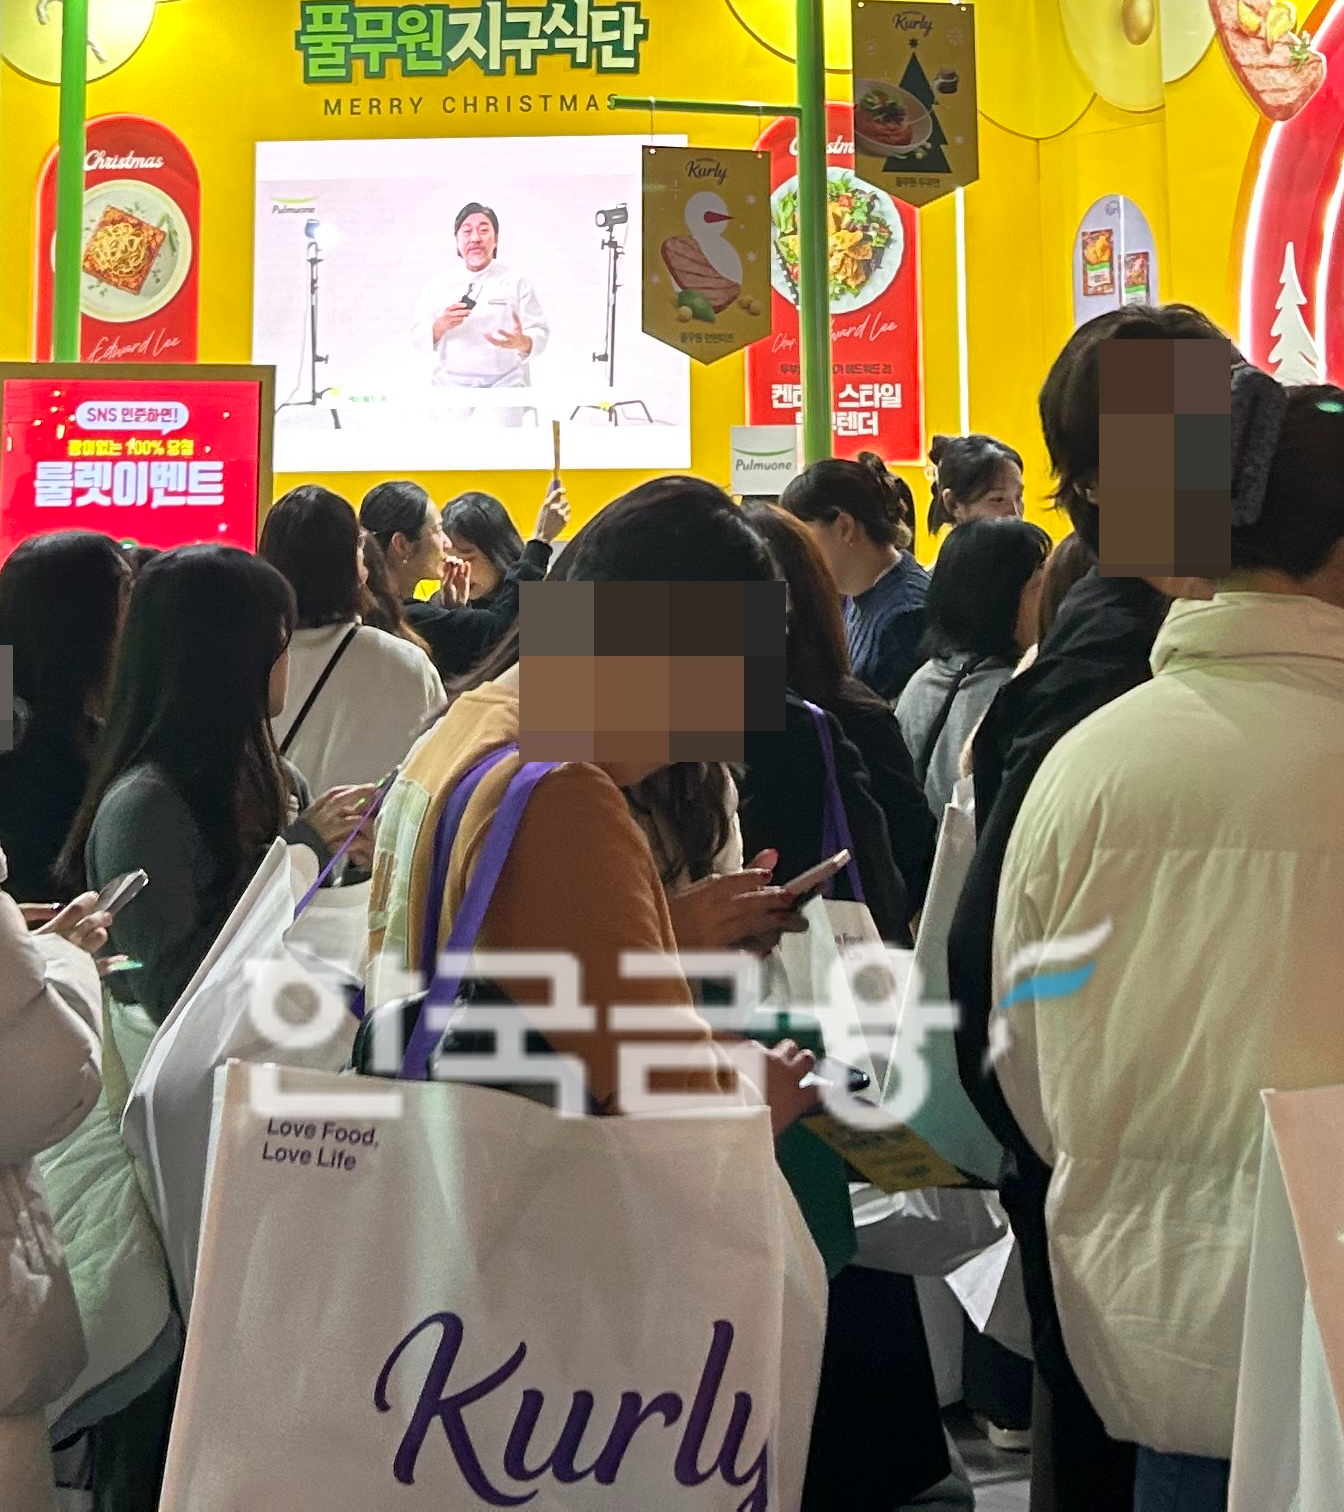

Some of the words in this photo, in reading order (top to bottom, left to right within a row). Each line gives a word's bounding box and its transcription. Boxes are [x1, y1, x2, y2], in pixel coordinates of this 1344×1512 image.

[892, 13, 933, 37] Kurly
[324, 96, 423, 116] MERRY
[83, 150, 164, 171] Christmas
[686, 160, 727, 185] Kurly
[838, 383, 902, 408] 스타일
[86, 407, 117, 423] SNS
[125, 438, 165, 456] 100%
[736, 458, 792, 471] Pulmuone
[34, 461, 225, 508] 룰렛이벤트
[267, 1117, 317, 1139] Love
[321, 1120, 379, 1149] Food,
[262, 1141, 312, 1165] Love
[316, 1146, 356, 1171] Life
[373, 1311, 768, 1512] Kurly
